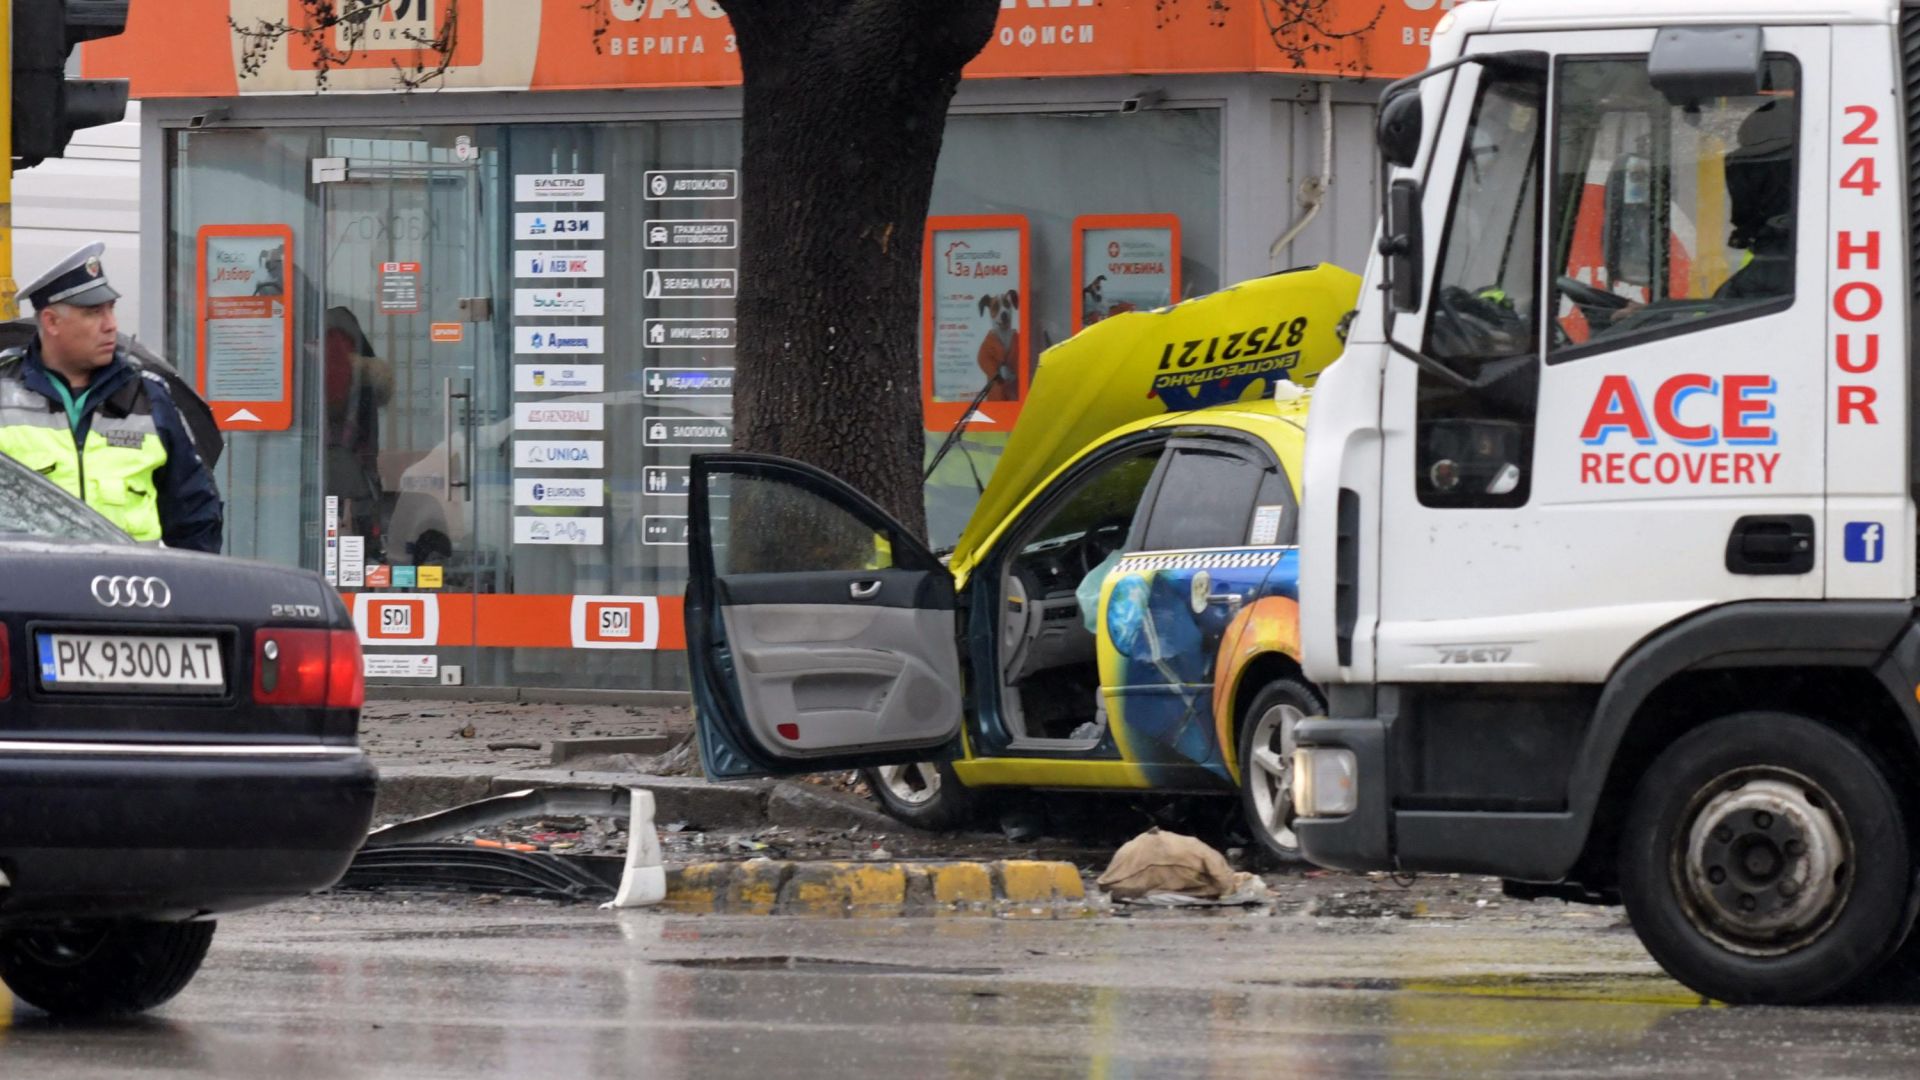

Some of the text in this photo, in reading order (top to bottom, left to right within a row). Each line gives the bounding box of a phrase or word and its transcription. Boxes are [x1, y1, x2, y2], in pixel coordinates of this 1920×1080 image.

[1000, 24, 1094, 47] ОФИСИ
[610, 35, 705, 56] ВЕРИГА
[673, 179, 728, 191] АВТОКАСКО
[553, 220, 589, 232] ДЗИ
[673, 224, 728, 234] ГРАЖДАНСКА
[550, 260, 567, 273] ЛЕВ
[973, 262, 1008, 279] Дома
[663, 278, 732, 289] ЗЕЛЕНА КАРТА
[670, 328, 729, 340] ИМУЩЕСТВО
[1832, 230, 1883, 425] HOUR
[1157, 315, 1308, 371] 8752121
[1155, 353, 1296, 389] ЕКСПРЕСТРАНС
[666, 376, 732, 389] МЕДИЦИНСКИ
[543, 409, 590, 423] GENERALI
[1579, 373, 1778, 446] ACE
[673, 425, 728, 438] ЗЛОПОЛУКА
[546, 447, 590, 461] UNIQA
[1580, 452, 1781, 484] RECOVERY
[547, 487, 586, 498] EUROINS
[383, 608, 409, 626] SDI
[602, 611, 628, 629] SDI
[101, 641, 171, 678] 9300
